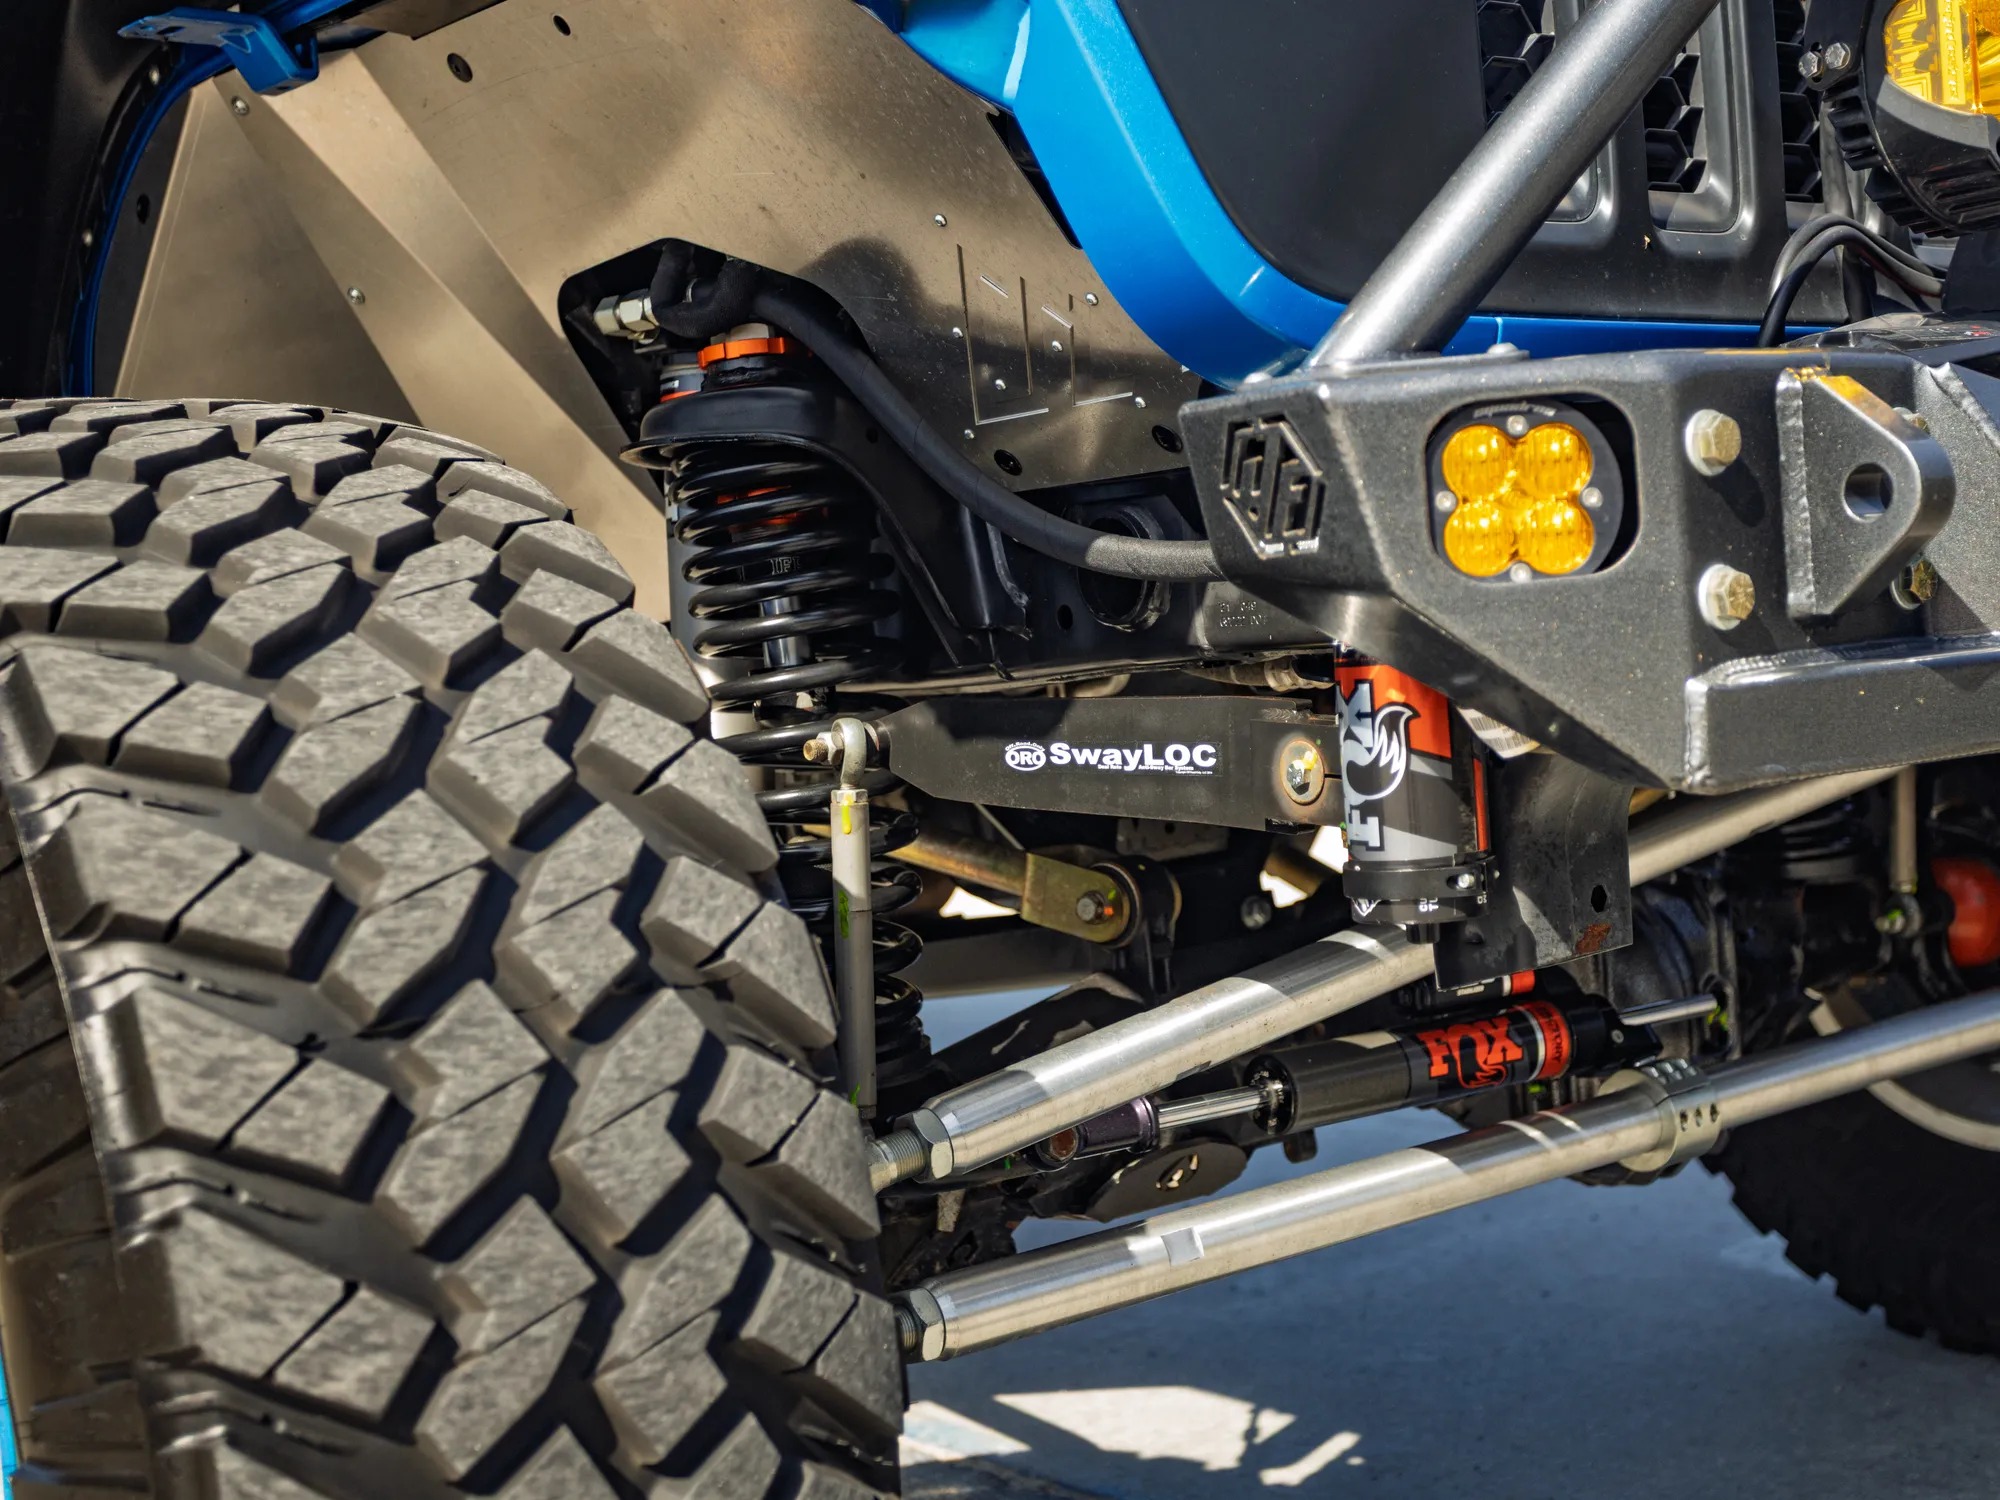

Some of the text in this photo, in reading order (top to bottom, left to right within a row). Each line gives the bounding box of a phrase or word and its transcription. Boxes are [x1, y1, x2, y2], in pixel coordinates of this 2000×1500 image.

[1005, 743, 1217, 772] ORO SwayLOC
[1336, 680, 1408, 850] FOX
[1416, 1016, 1523, 1088] FOX
